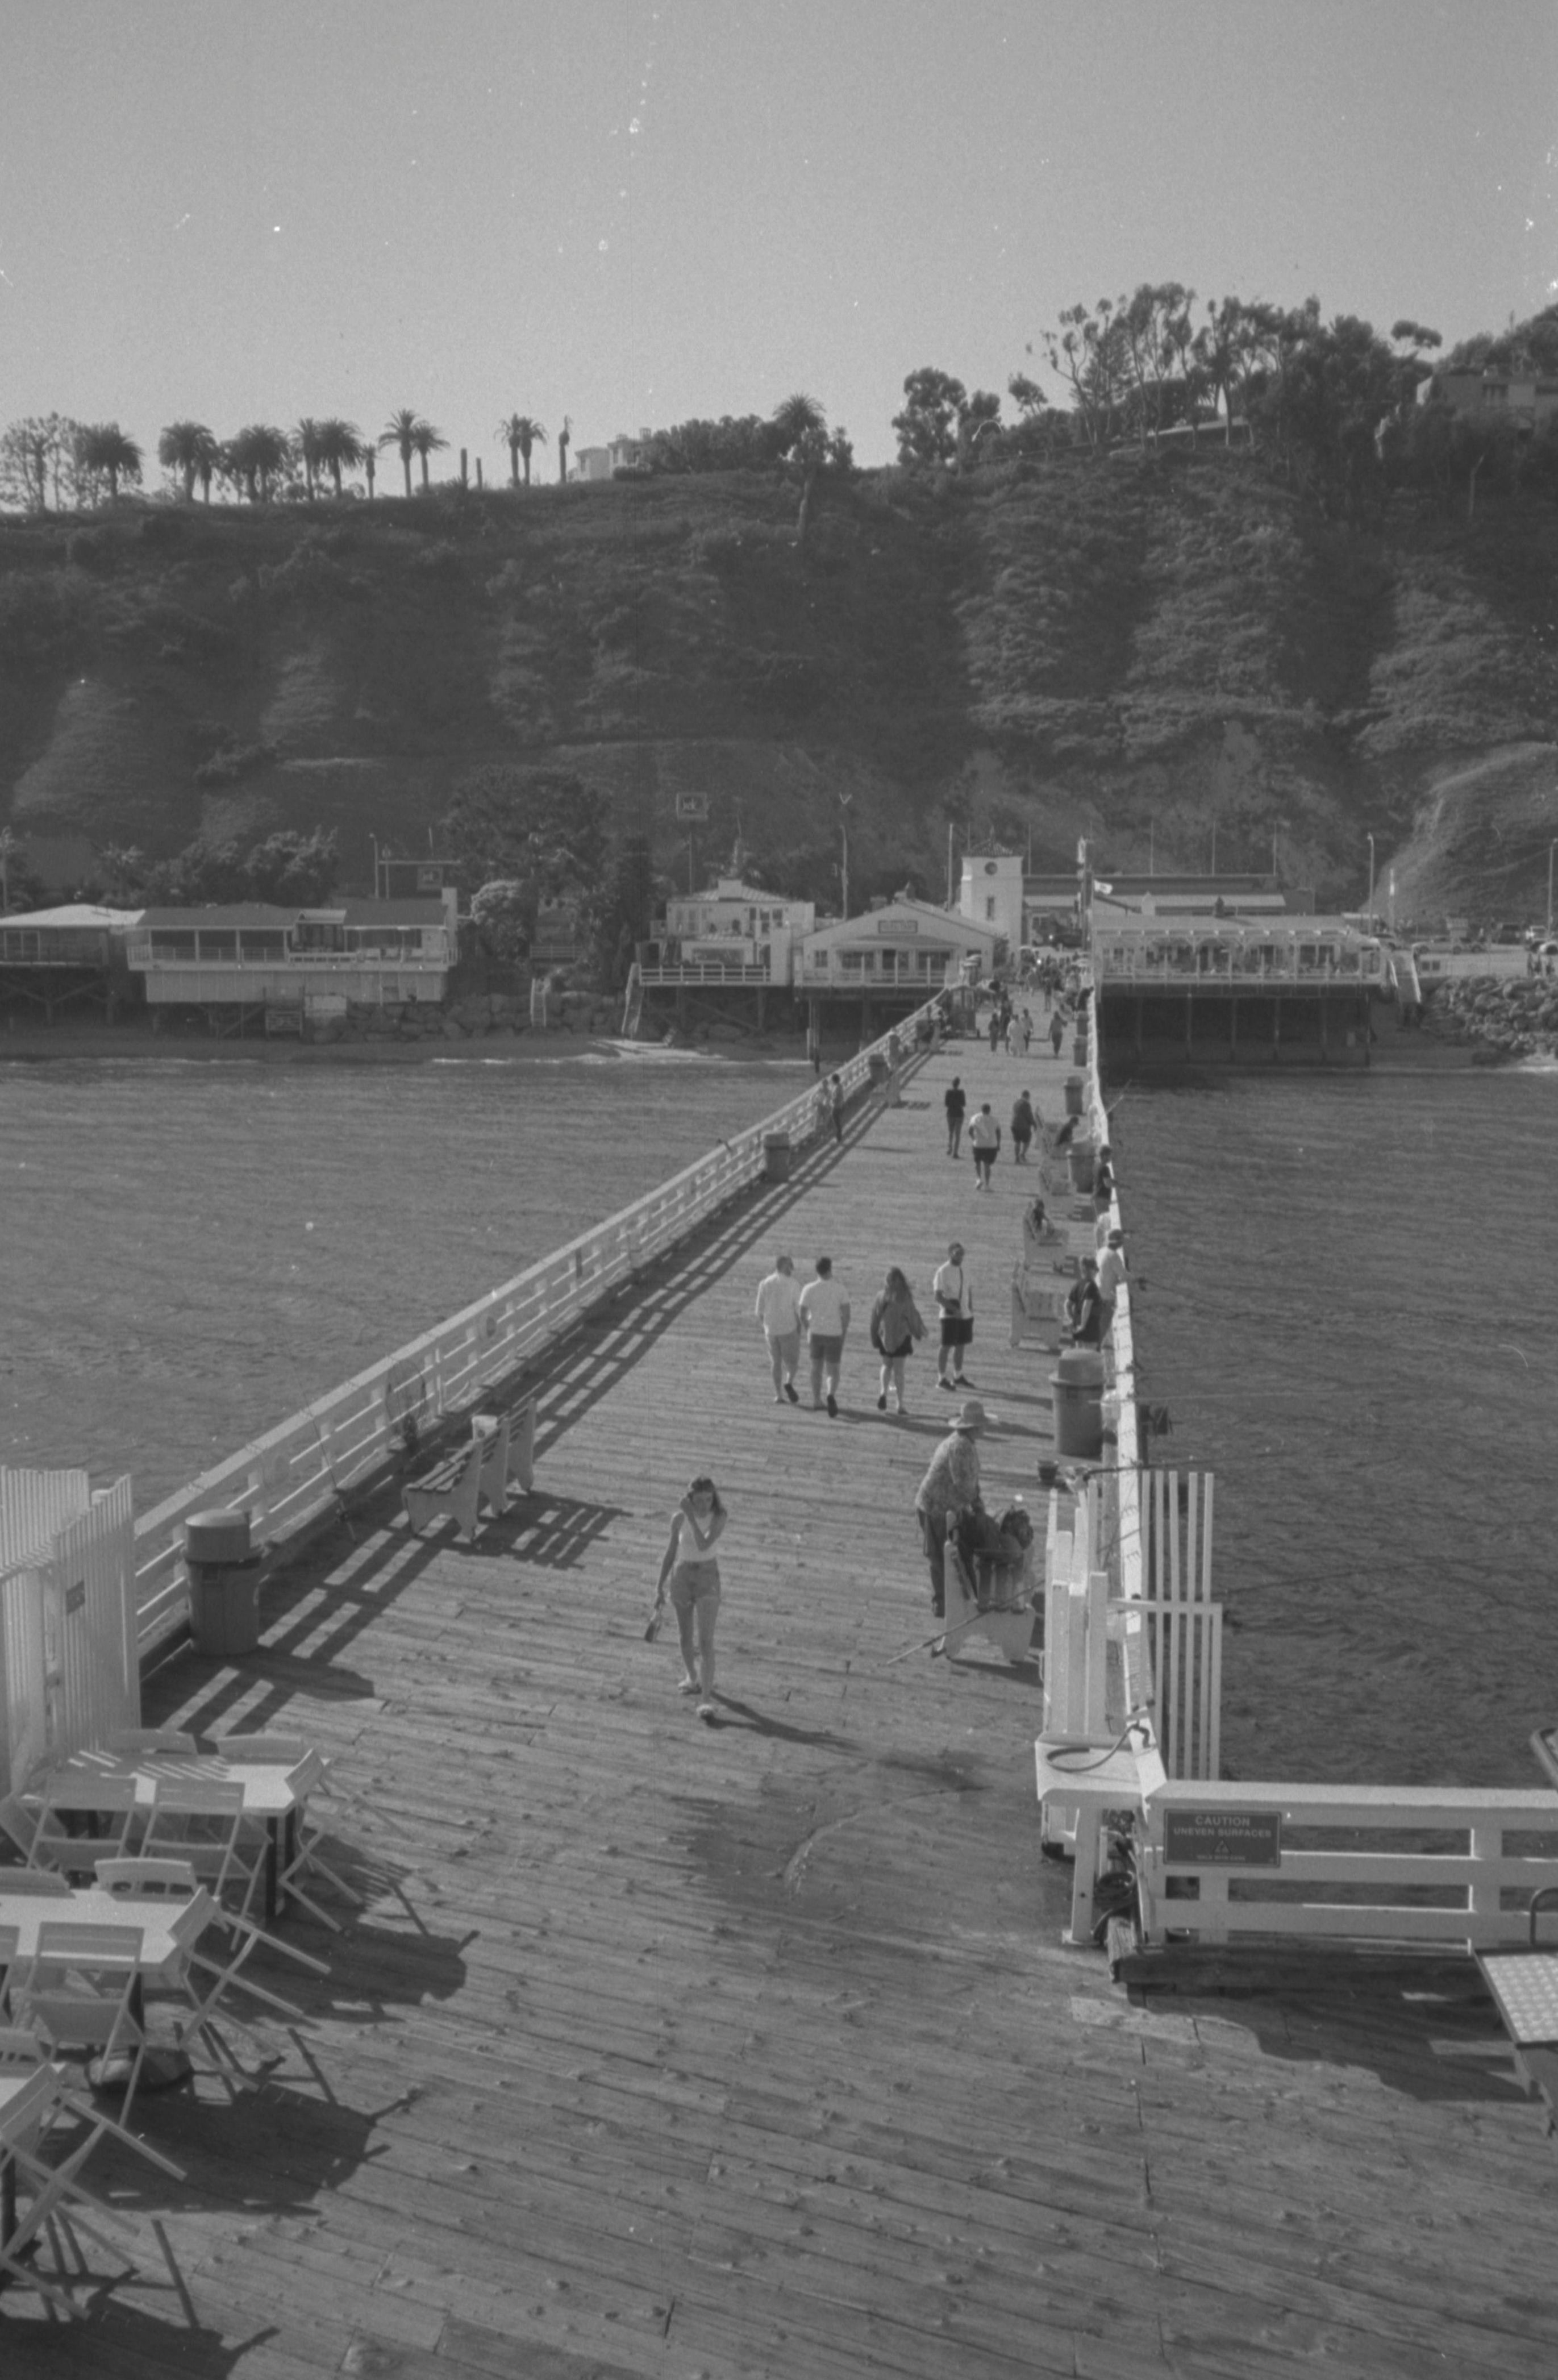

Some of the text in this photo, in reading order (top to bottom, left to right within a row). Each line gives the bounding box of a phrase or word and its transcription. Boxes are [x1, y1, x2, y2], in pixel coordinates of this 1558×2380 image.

[1195, 1816, 1250, 1826] CAUTION
[1174, 1827, 1271, 1838] UNEVEN SURFACES
